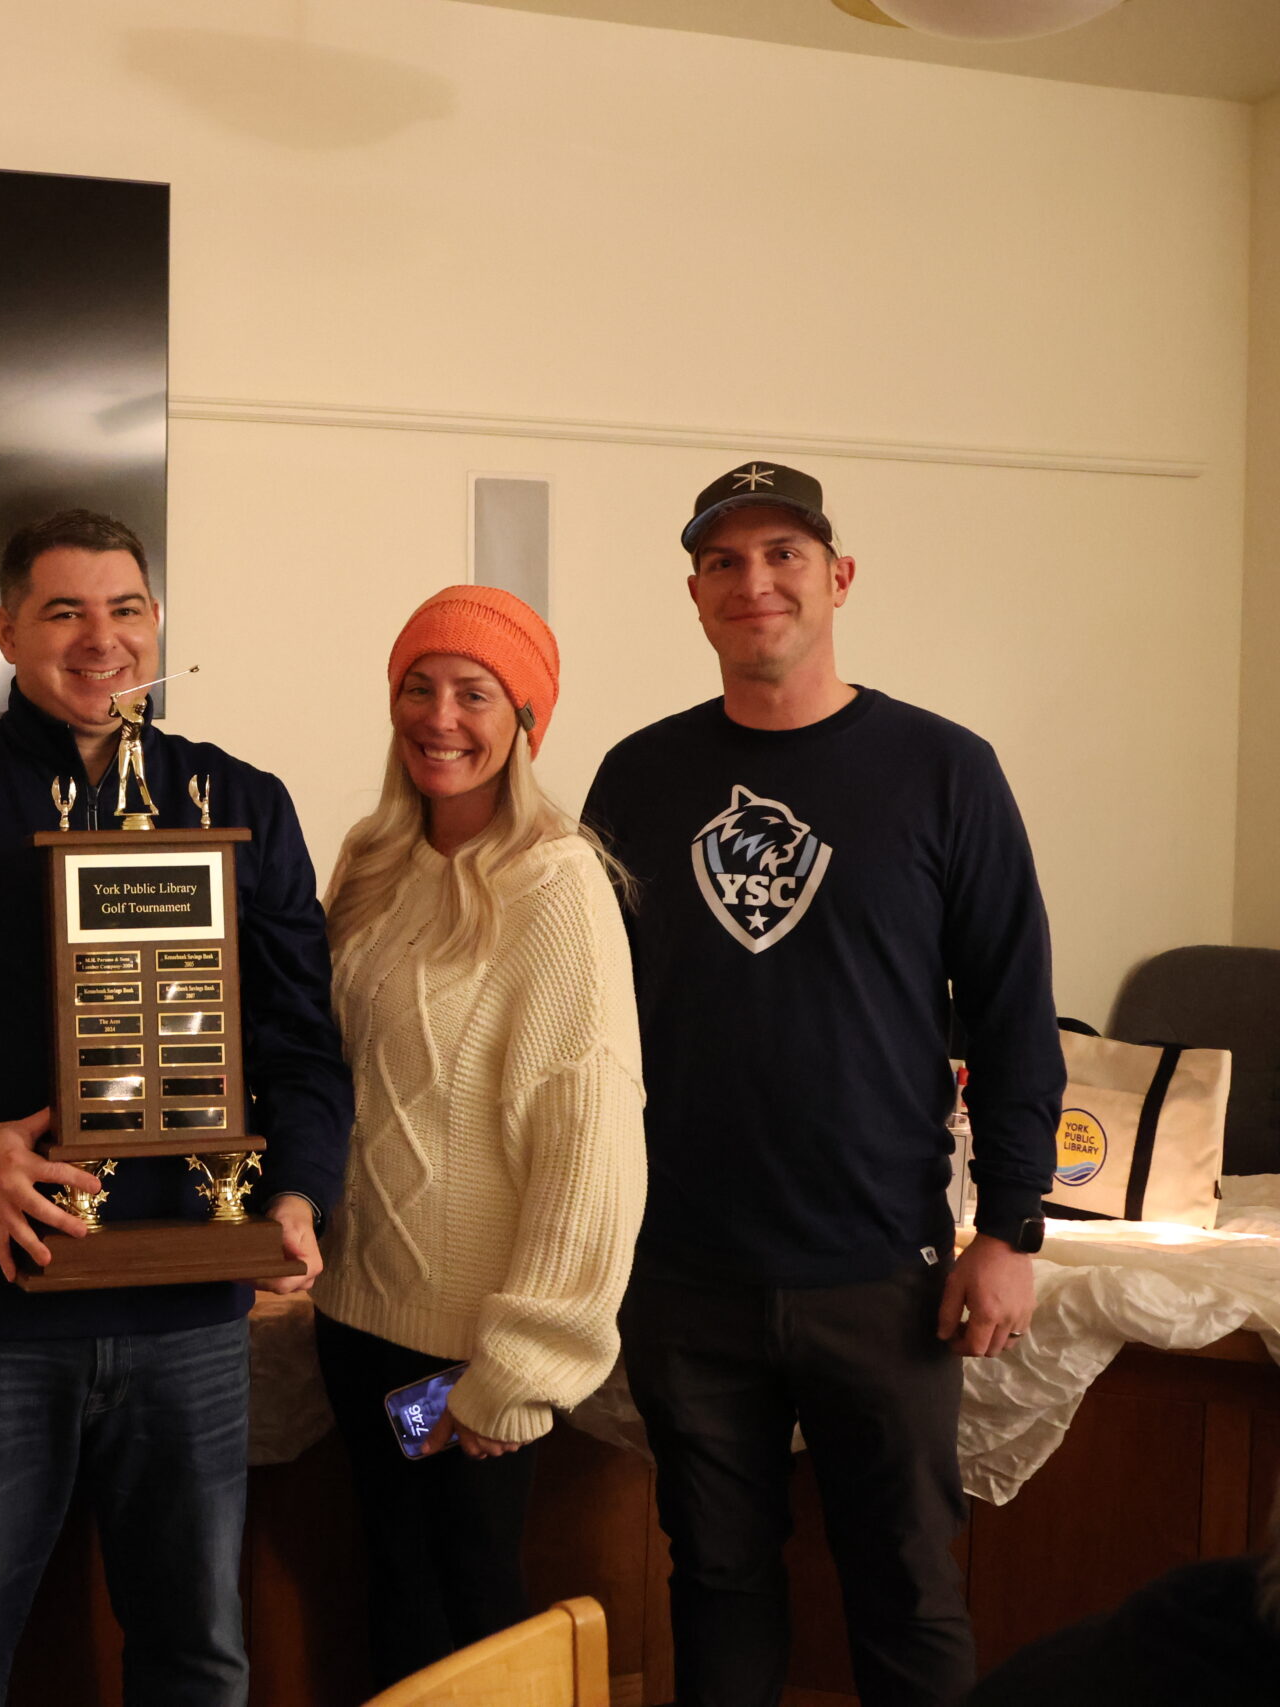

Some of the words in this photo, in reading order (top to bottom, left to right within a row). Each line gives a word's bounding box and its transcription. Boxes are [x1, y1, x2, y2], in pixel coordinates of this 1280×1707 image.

[94, 884, 120, 895] York
[123, 883, 156, 894] Public
[159, 882, 197, 896] Library
[716, 873, 796, 908] YSC
[101, 902, 127, 914] Golf
[129, 902, 191, 913] Tournament
[1066, 1122, 1089, 1134] YORK
[1064, 1132, 1095, 1144] PUBLIC
[1064, 1141, 1099, 1154] LIBRARY
[408, 1404, 429, 1436] 7:46
